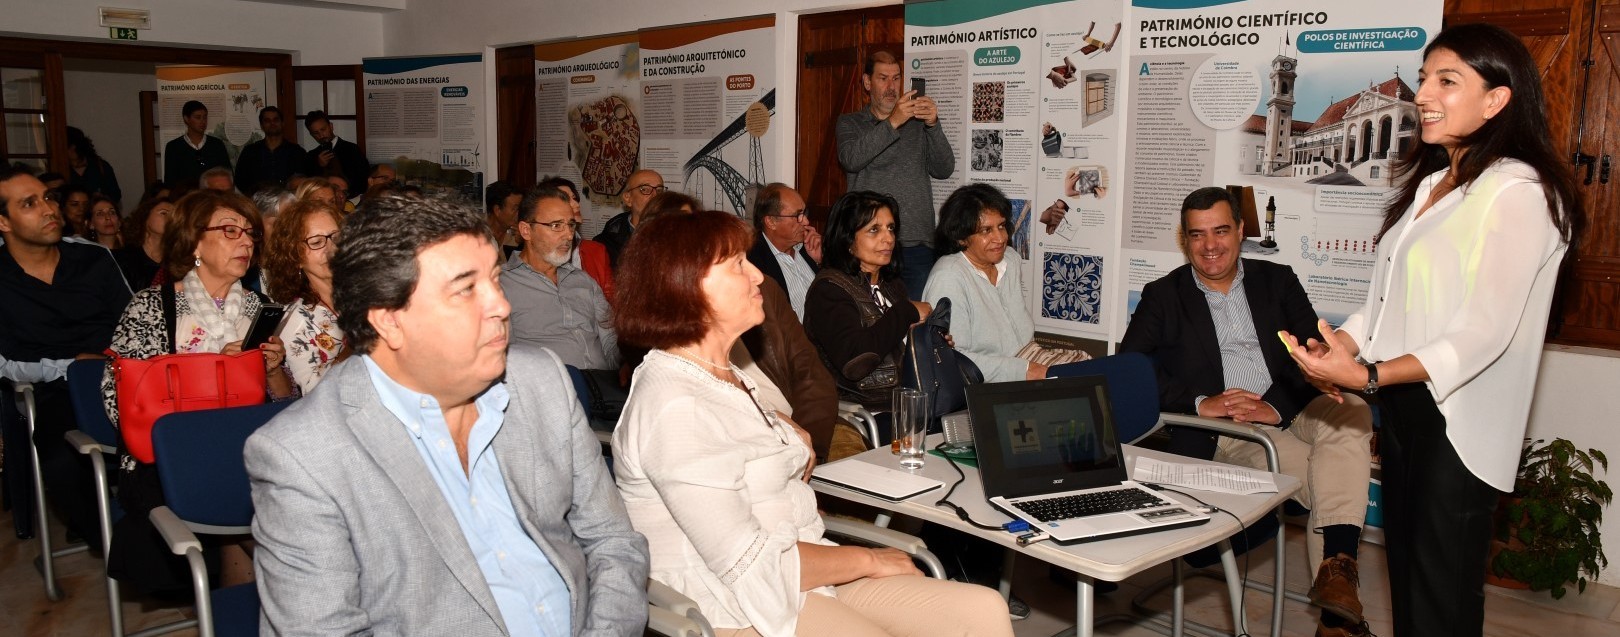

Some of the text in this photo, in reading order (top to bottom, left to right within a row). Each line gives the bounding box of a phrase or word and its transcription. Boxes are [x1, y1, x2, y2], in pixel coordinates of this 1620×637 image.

[1140, 10, 1328, 32] PATRIMÓNIO CIENTÍFICO
[911, 27, 1037, 46] PATRIMÓNIO ARTÍSTICO
[1140, 31, 1260, 48] E TECNOLÓGICO
[1304, 33, 1334, 41] POLOS
[1349, 29, 1418, 41] INVESTIGAÇÃO
[1334, 40, 1385, 50] CIENTÍFICA
[643, 48, 746, 65] PATRIMÓNIO ARQUITETÓNICO
[988, 56, 1015, 64] AZULEJO
[538, 61, 620, 75] PATRIMÓNIO ARQUEOLÓGICO
[643, 63, 705, 76] E DA CONSTRUÇÃO
[912, 58, 920, 70] O
[1139, 62, 1150, 76] A
[196, 83, 226, 91] AGRÍCOLA
[367, 78, 405, 86] PATRIMÓNIO
[406, 77, 419, 85] DAS
